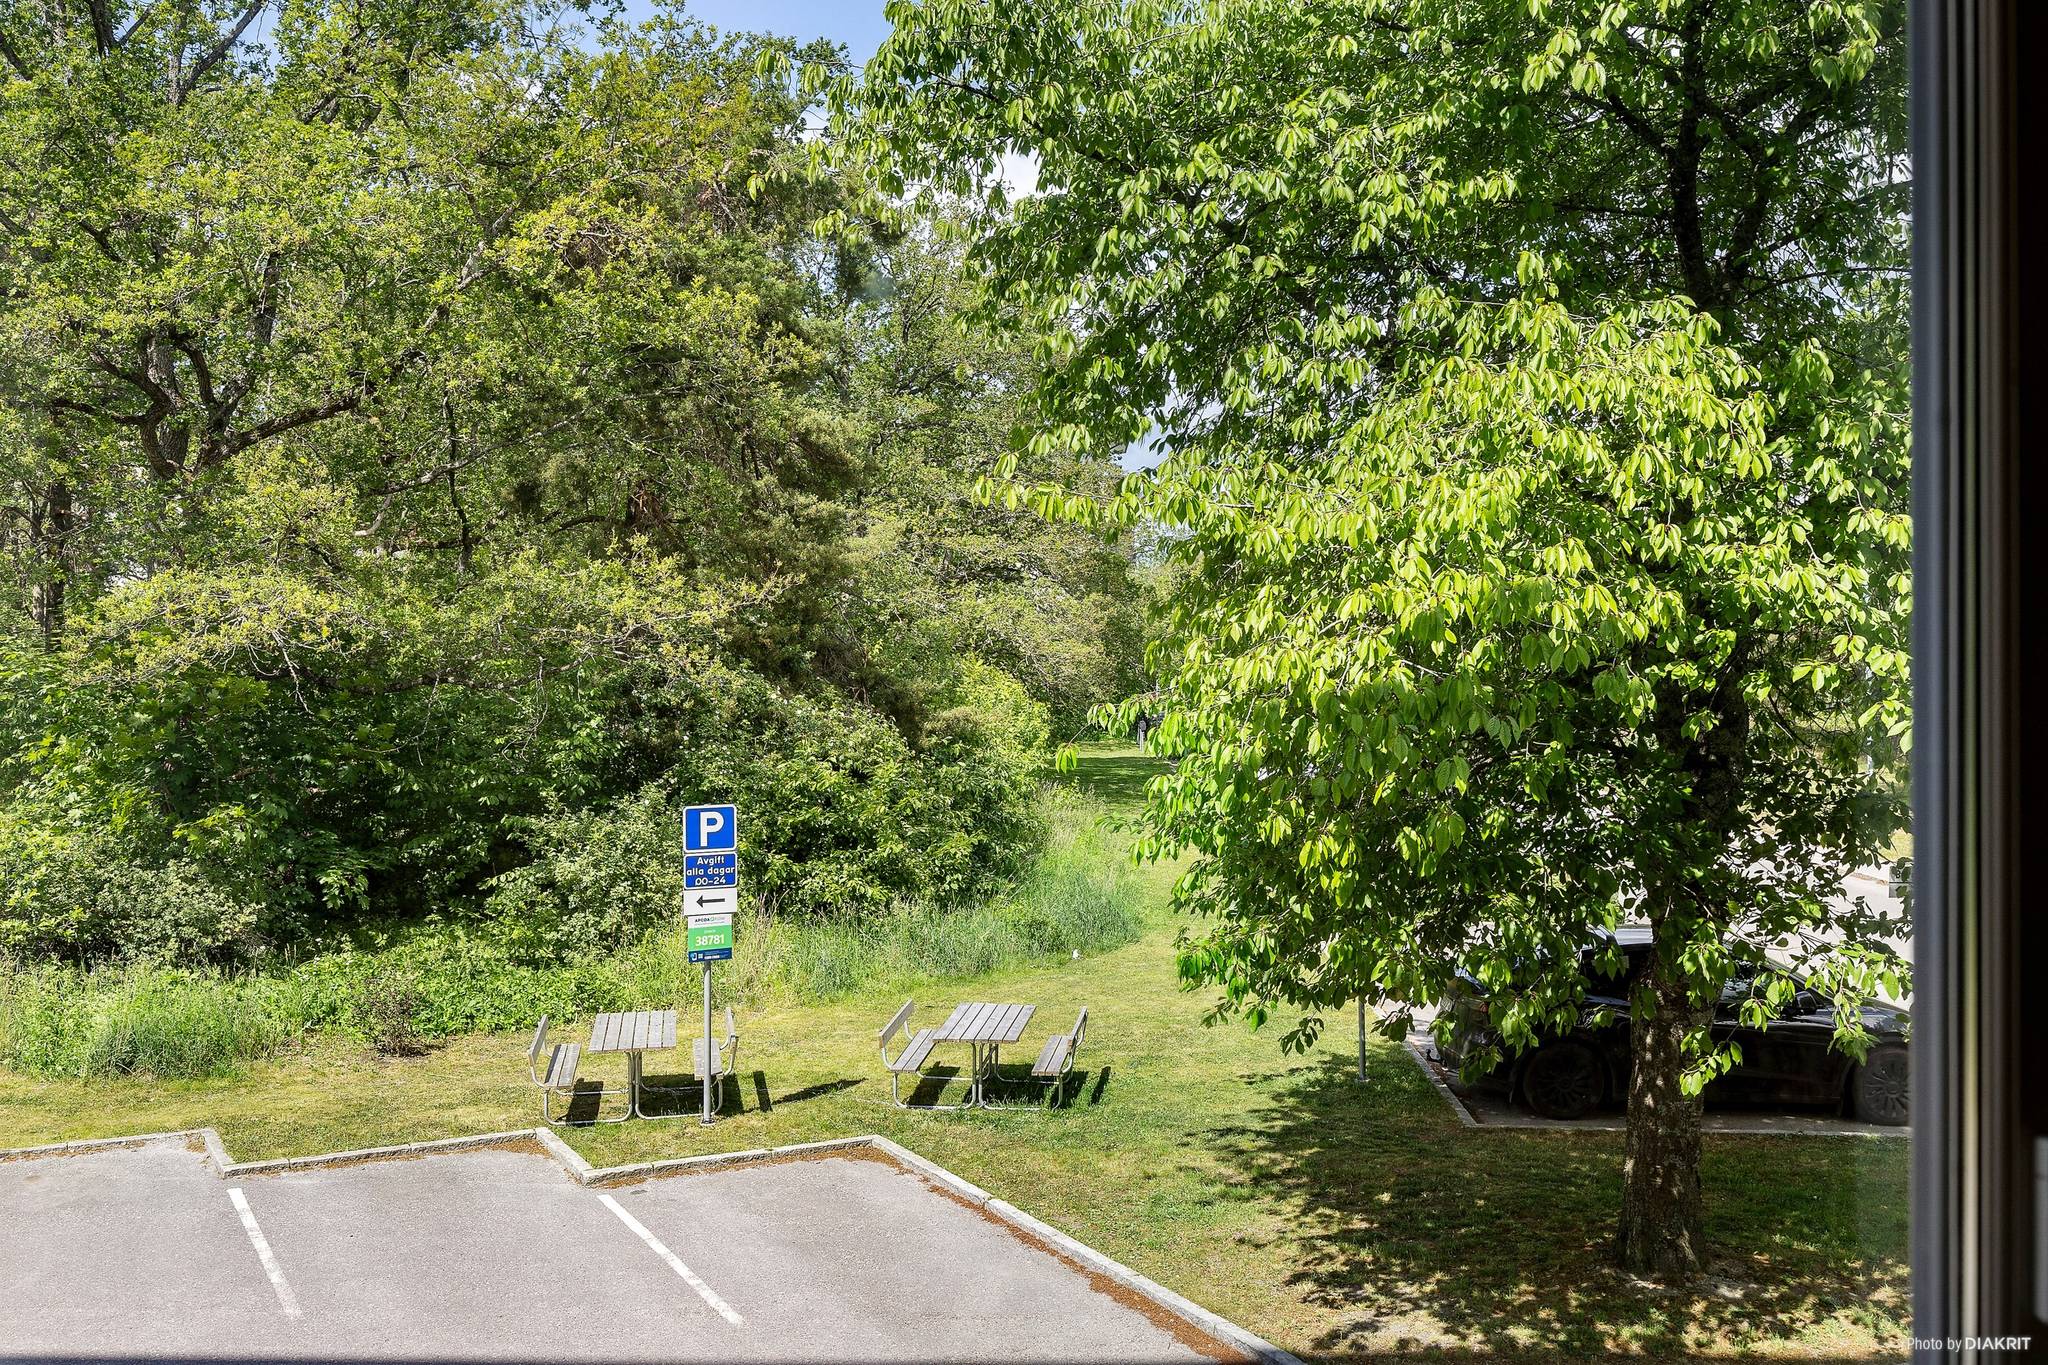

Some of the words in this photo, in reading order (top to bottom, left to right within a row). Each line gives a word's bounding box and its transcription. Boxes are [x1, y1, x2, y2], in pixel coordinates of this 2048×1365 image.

[700, 811, 725, 847] P
[697, 856, 724, 865] Avgift
[687, 868, 704, 876] alla
[707, 867, 734, 875] dagar
[695, 877, 726, 886] 00-24
[695, 934, 725, 947] 38781
